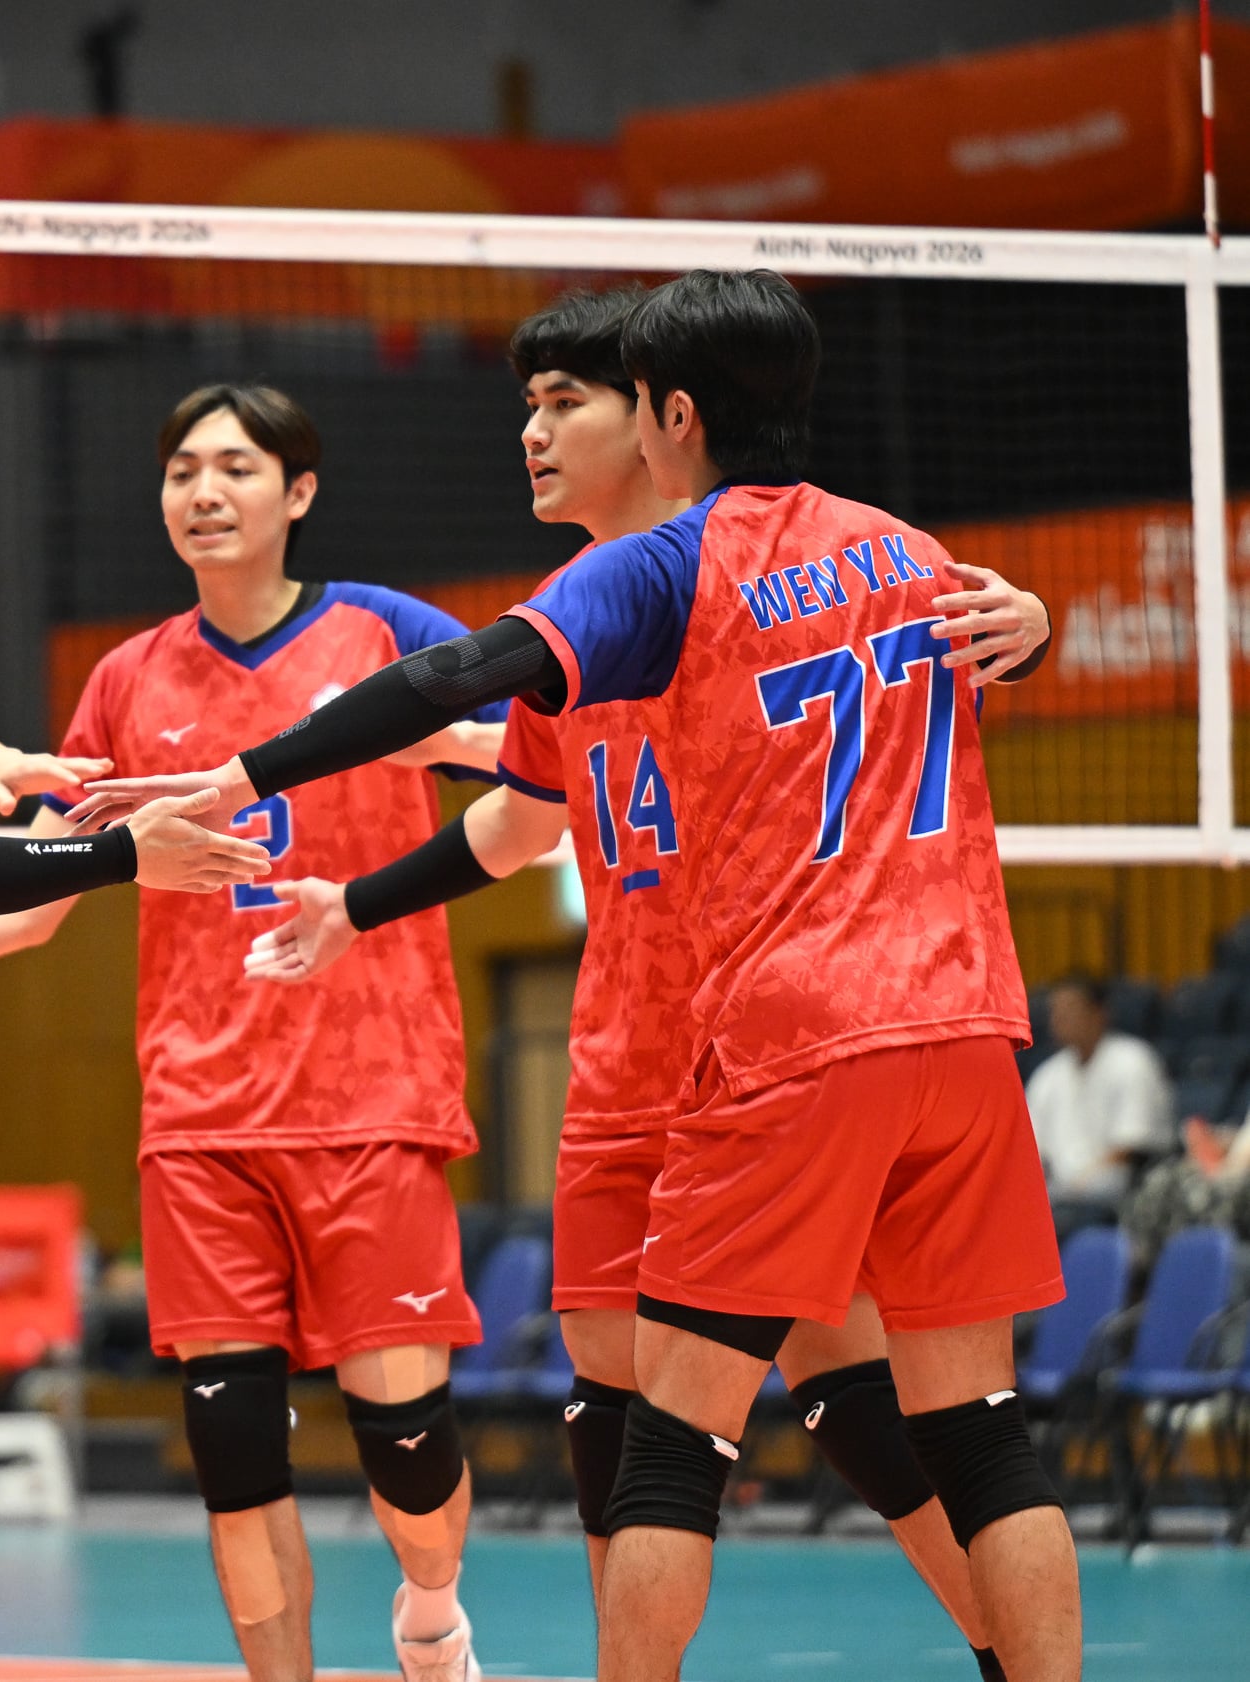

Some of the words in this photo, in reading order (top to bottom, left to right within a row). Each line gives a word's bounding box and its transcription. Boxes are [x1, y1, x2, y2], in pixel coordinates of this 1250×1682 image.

[738, 555, 849, 631] WEN
[842, 534, 934, 593] Y.K.
[586, 734, 680, 869] 14
[754, 615, 955, 865] 77
